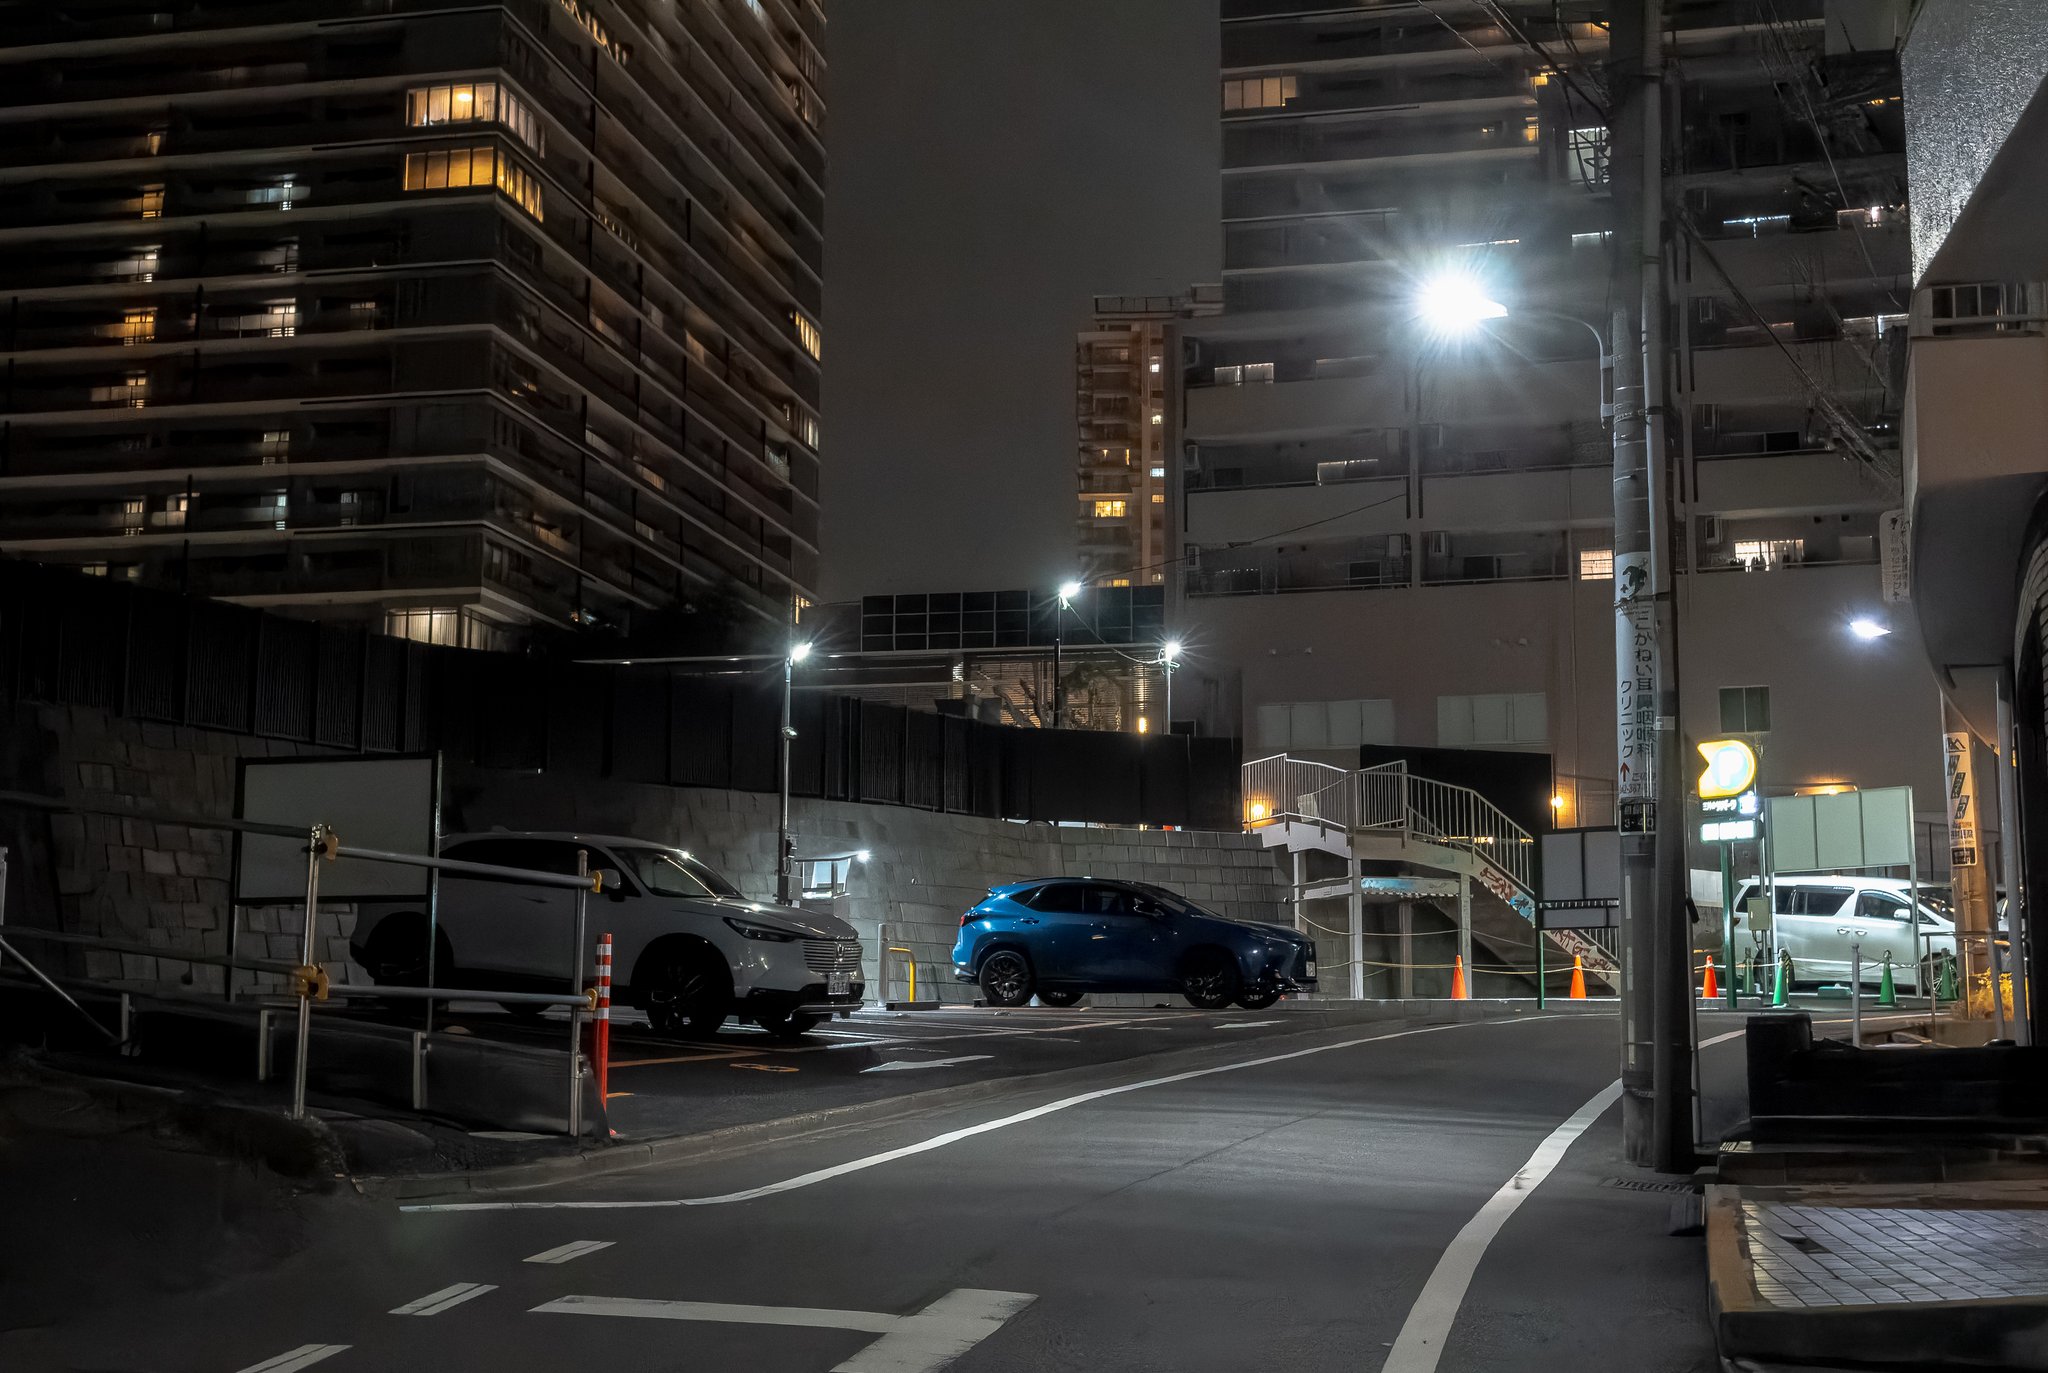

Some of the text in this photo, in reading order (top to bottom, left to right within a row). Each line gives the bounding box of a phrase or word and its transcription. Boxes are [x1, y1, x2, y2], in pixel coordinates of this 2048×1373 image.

[1621, 680, 1634, 758] クリニック
